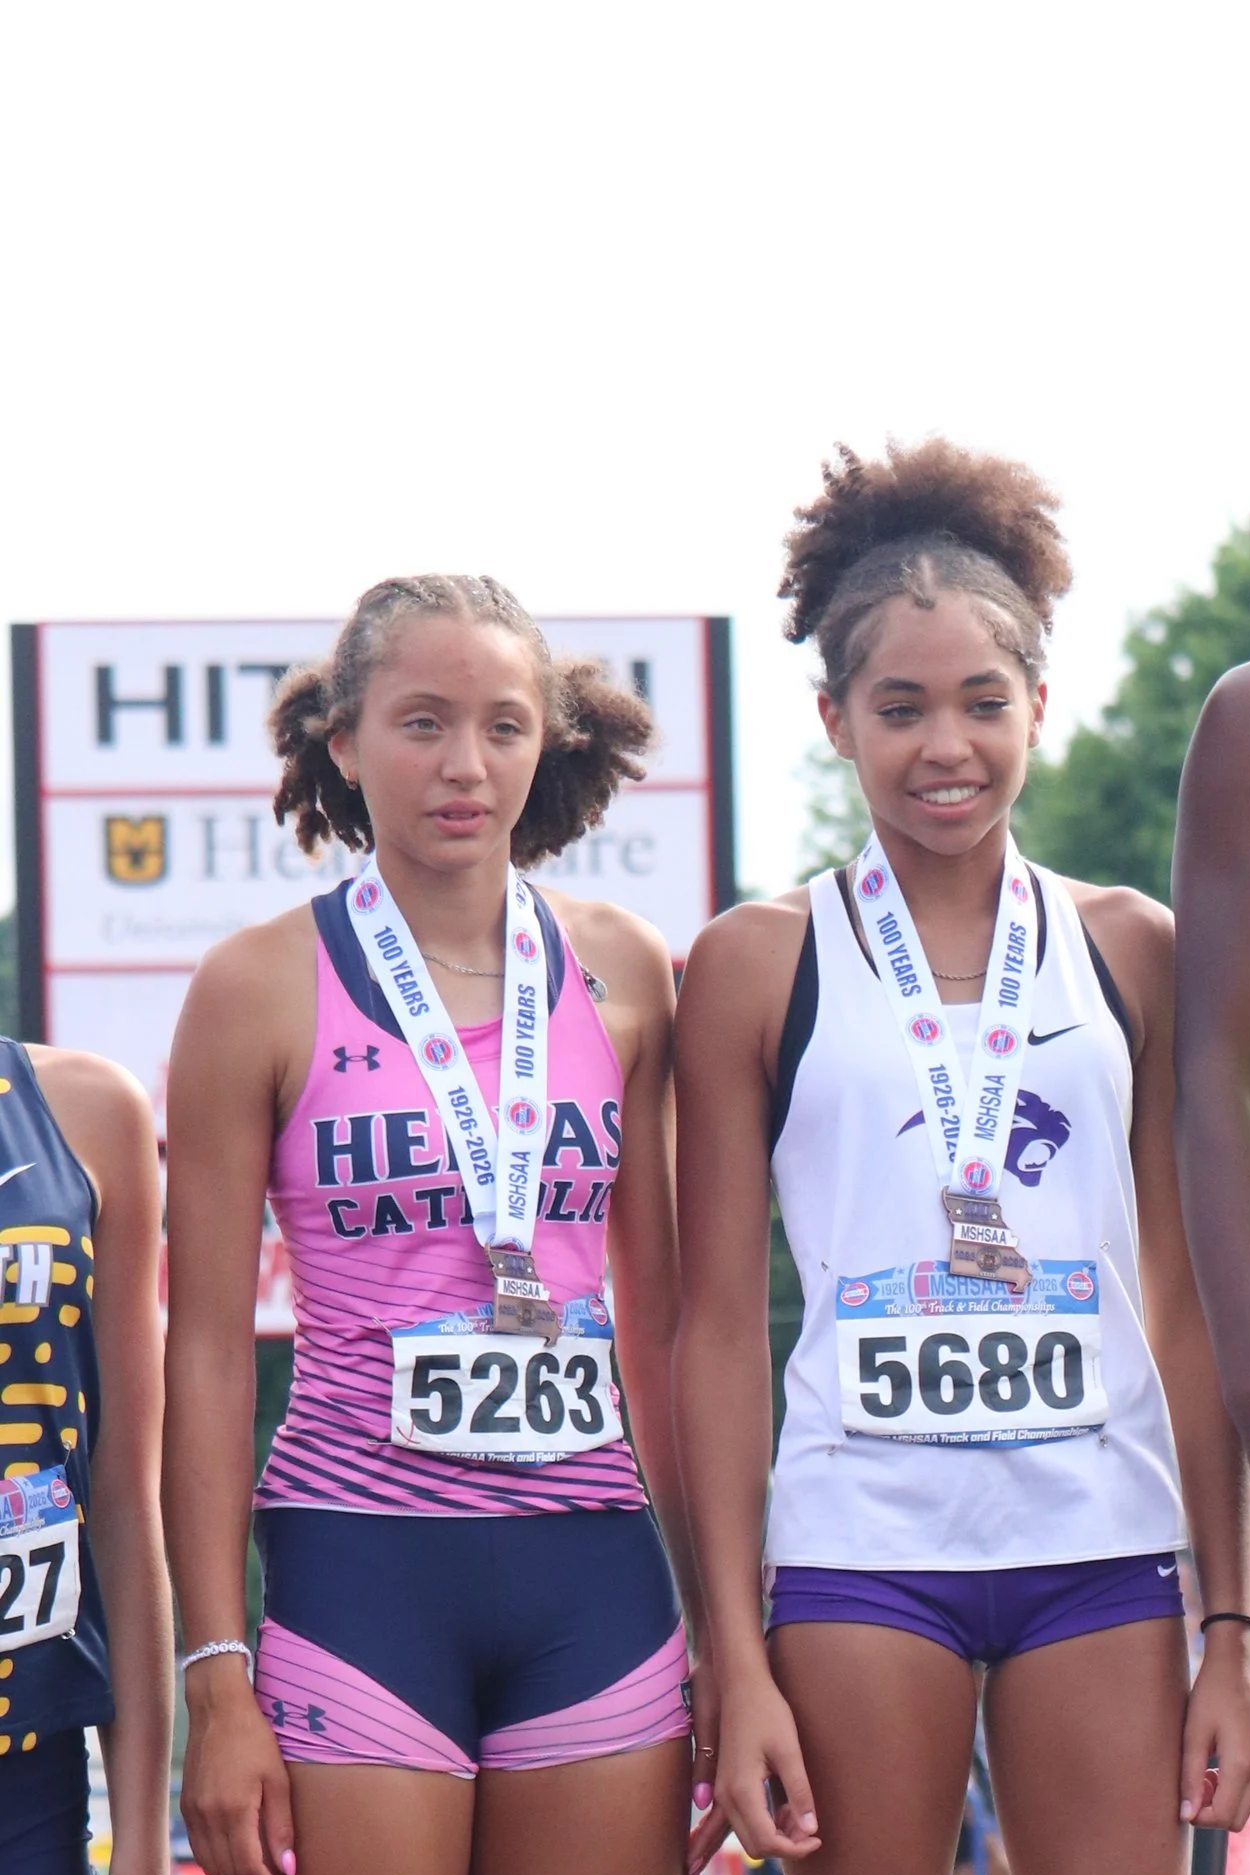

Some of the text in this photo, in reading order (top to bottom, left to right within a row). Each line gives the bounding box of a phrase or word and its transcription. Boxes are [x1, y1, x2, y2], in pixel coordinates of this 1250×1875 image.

[373, 925, 431, 1018] 100 YEARS
[876, 911, 922, 998] 100 YEARS
[997, 921, 1027, 1009] 100 YEARS
[514, 983, 536, 1080] 100 YEARS
[311, 1099, 622, 1188] HEAS
[447, 1085, 496, 1187] 1926-2026
[974, 1075, 1006, 1141] MSHSAA
[508, 1150, 532, 1221] MSHSAA
[960, 1225, 1007, 1245] MSHSAA
[503, 1279, 541, 1298] MSHSAA
[881, 1282, 905, 1297] 1926
[930, 1274, 1007, 1297] MSHSAA
[1032, 1278, 1058, 1292] 2026
[885, 1303, 901, 1315] The
[928, 1301, 954, 1313] Track
[956, 1303, 965, 1312] &
[967, 1301, 989, 1312] Field
[991, 1300, 1055, 1316] Championships
[410, 1351, 604, 1435] 5263
[858, 1331, 1085, 1418] 5680
[516, 1452, 535, 1463] and
[536, 1452, 556, 1463] Field
[940, 1433, 969, 1443] Track
[971, 1431, 990, 1442] and
[992, 1430, 1016, 1441] Field
